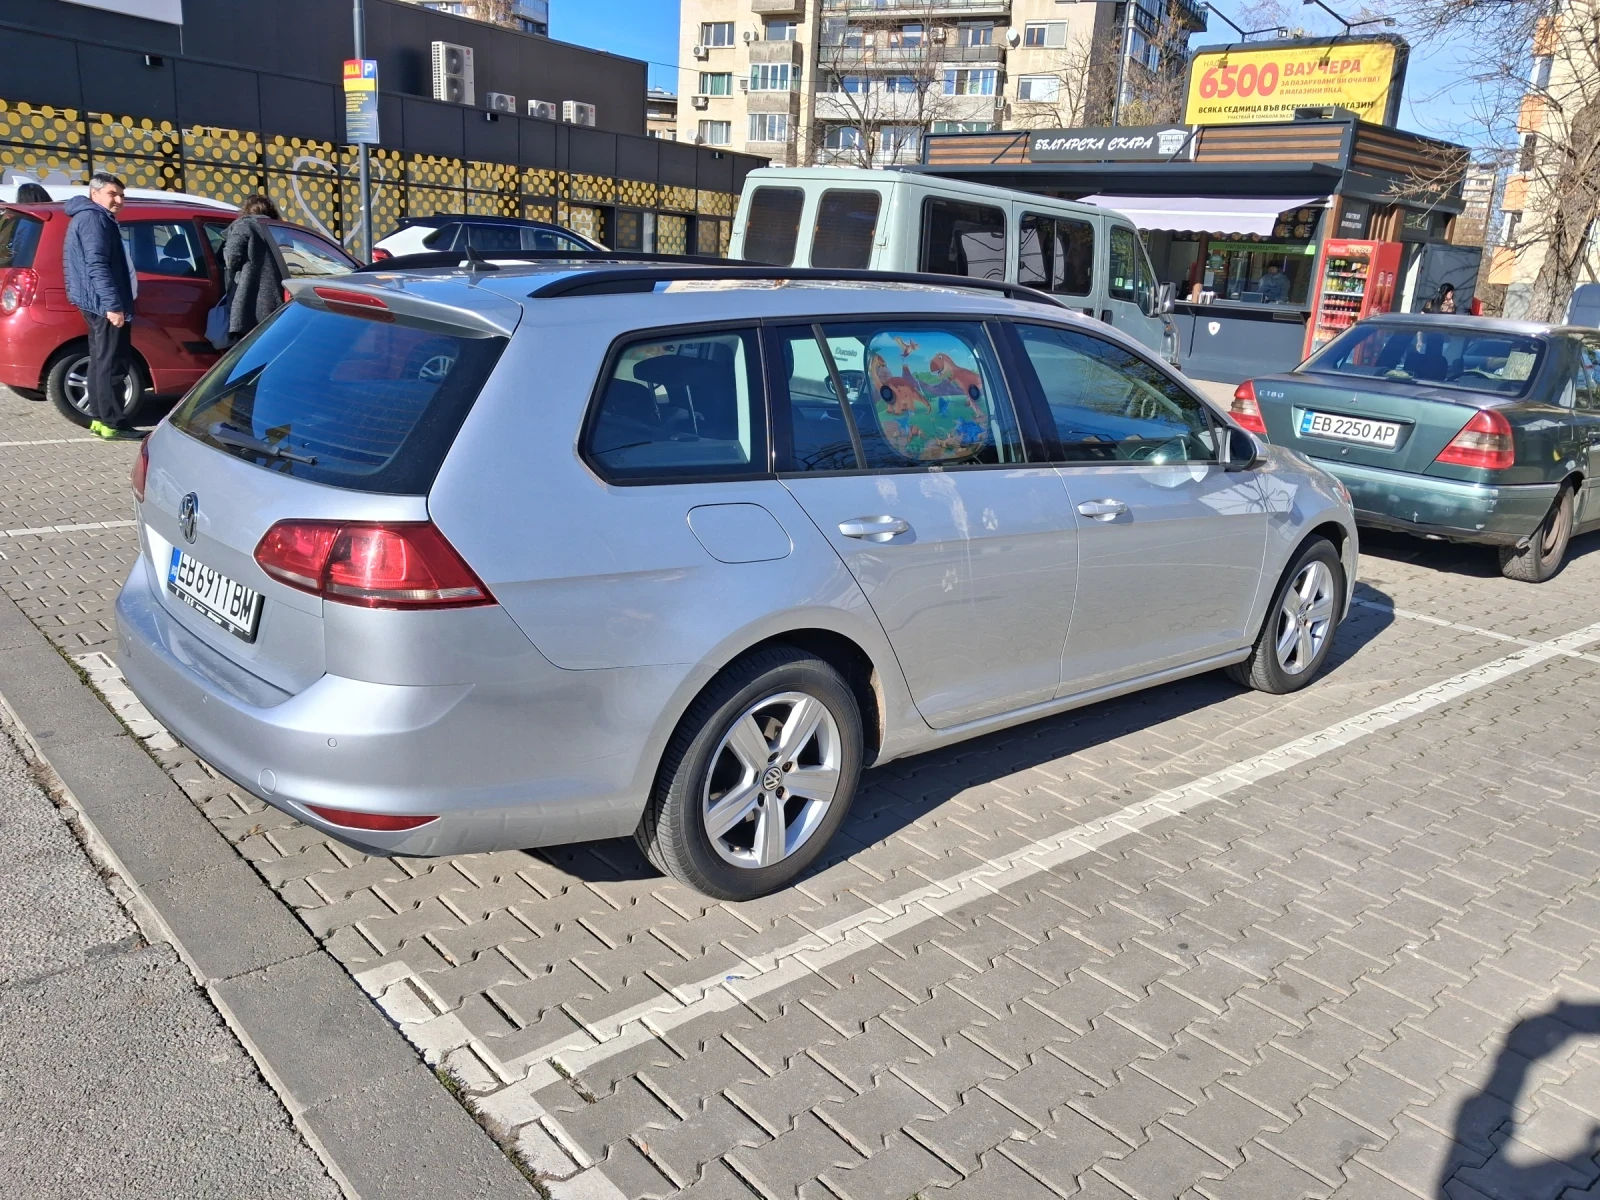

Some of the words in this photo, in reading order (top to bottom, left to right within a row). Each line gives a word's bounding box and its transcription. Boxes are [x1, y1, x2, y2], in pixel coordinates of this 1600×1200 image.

[364, 62, 373, 76] P
[1283, 58, 1361, 76] ВАУЧЕРА
[1199, 62, 1280, 99] 6500
[1290, 78, 1336, 86] ПАЗАРУВАНЕ
[1285, 87, 1322, 95] МАГАЗИНИ
[1223, 105, 1262, 113] СЕДМИЦА
[1333, 101, 1374, 109] МАГАЗИН
[1035, 137, 1105, 151] БЪЛГАРСКА
[1108, 136, 1153, 151] СКАРА
[835, 346, 858, 357] Ducato
[1312, 415, 1331, 432] EB
[1334, 419, 1371, 438] 2250
[1373, 426, 1395, 441] AP
